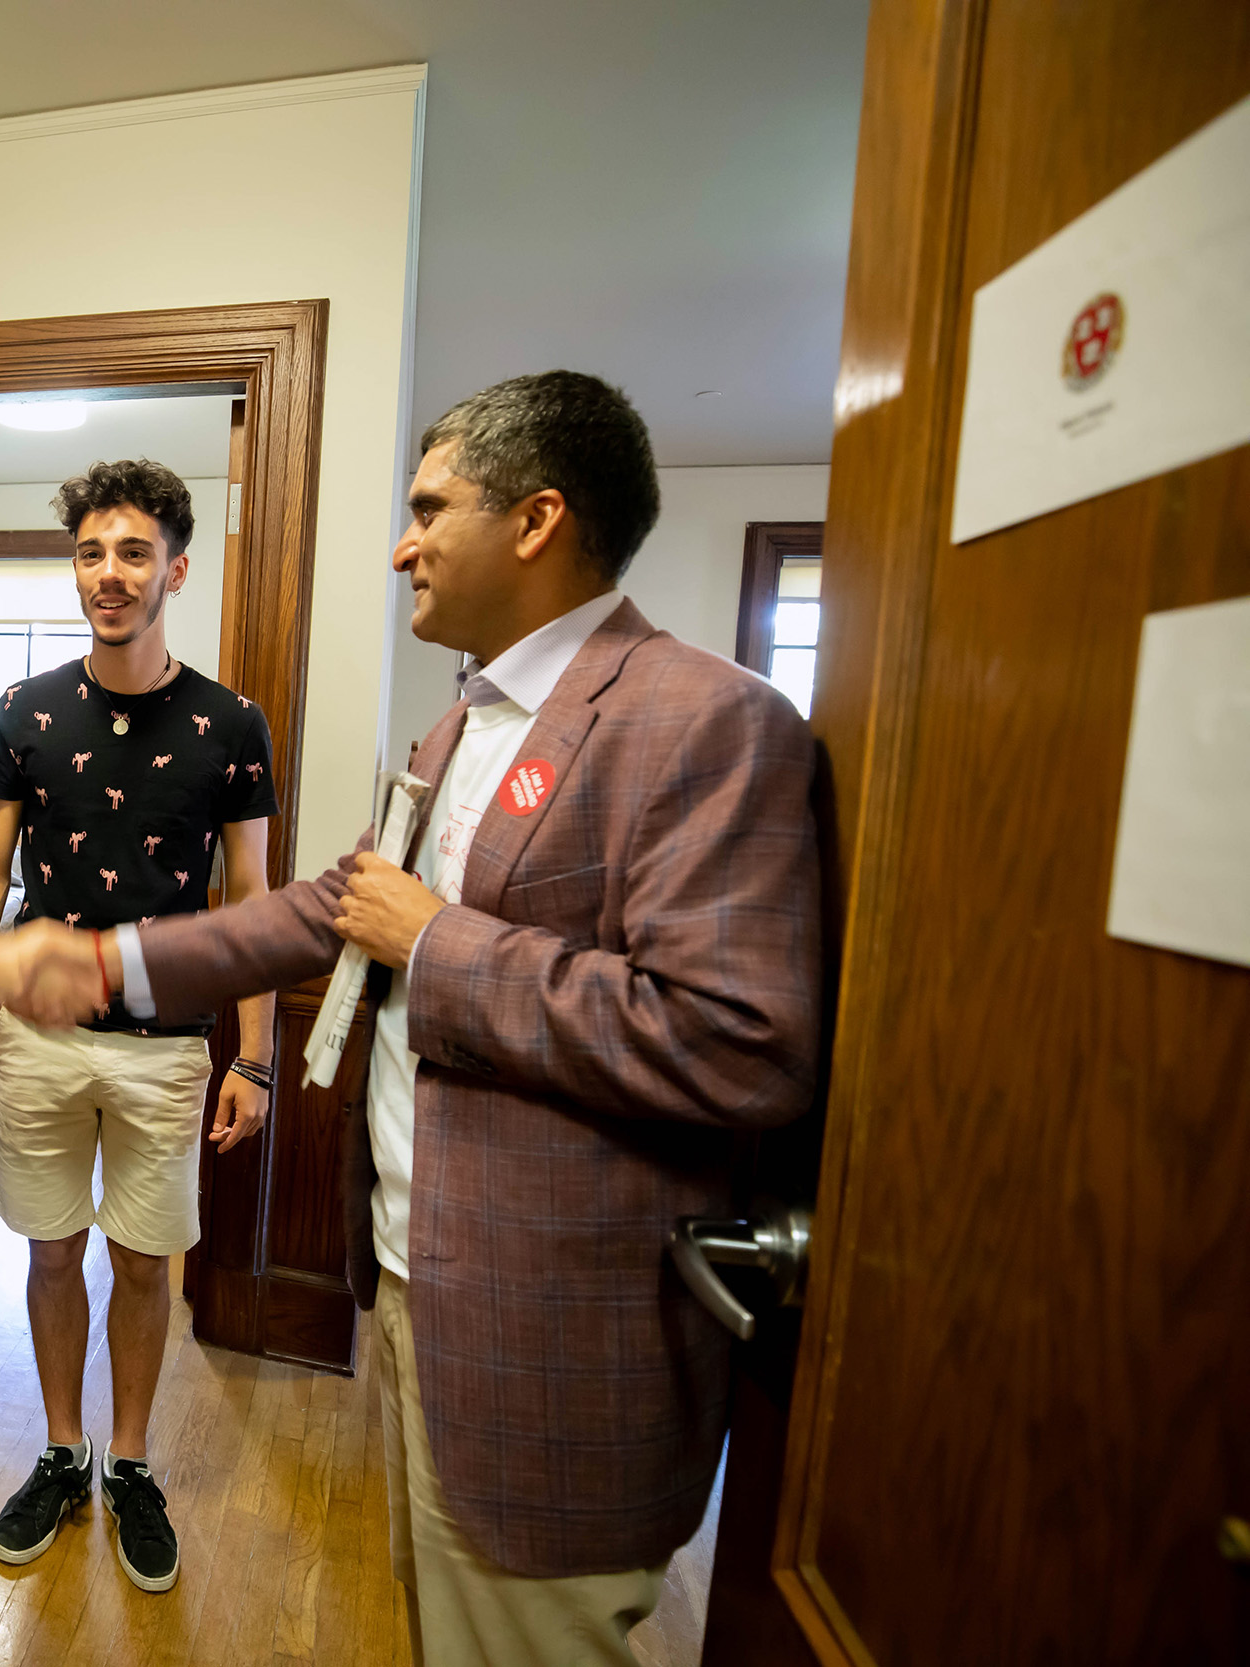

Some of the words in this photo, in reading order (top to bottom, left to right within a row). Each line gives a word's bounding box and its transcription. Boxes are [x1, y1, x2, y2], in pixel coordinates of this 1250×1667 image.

[517, 767, 538, 807] HARVARD
[530, 773, 544, 788] AM
[510, 778, 527, 808] VOTER
[535, 787, 546, 797] A
